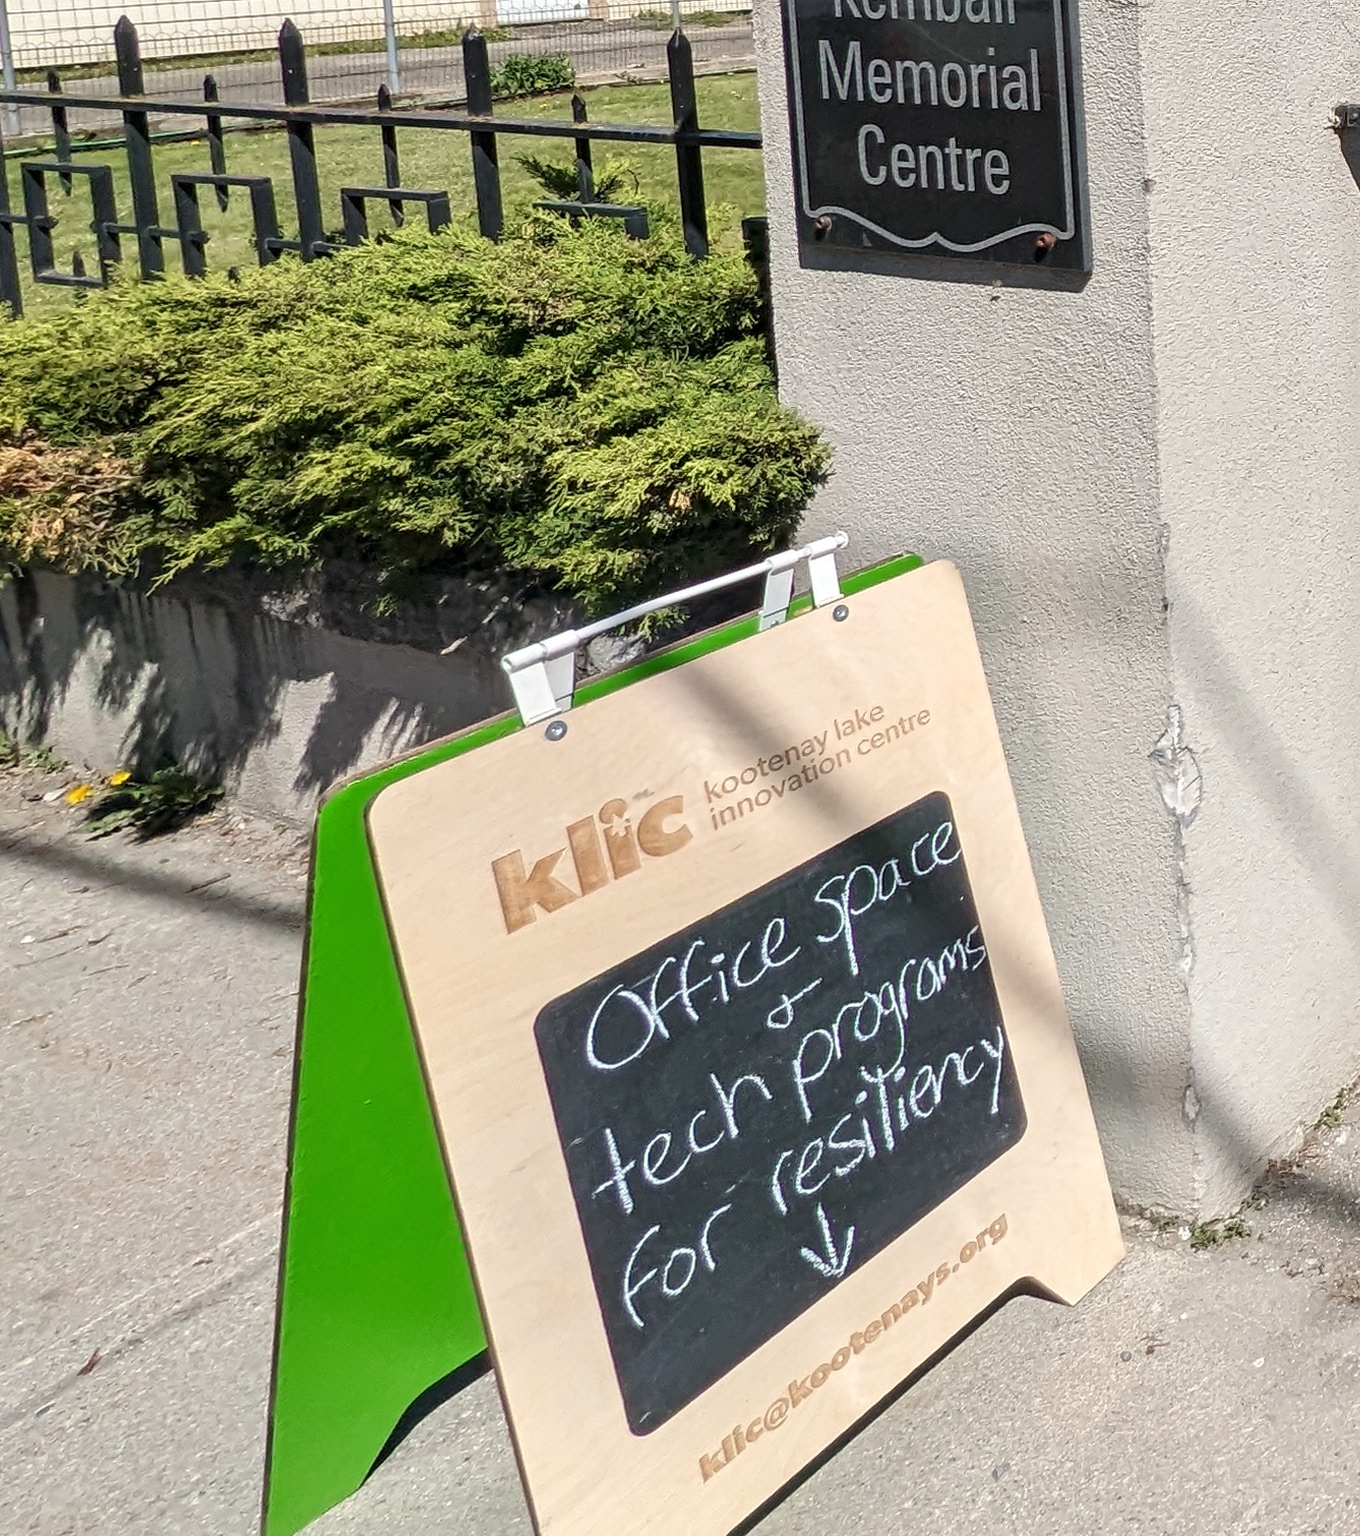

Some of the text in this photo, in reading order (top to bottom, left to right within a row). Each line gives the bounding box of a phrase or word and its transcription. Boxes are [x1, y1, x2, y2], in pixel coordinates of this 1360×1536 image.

[818, 39, 1041, 111] Memorial
[857, 123, 1011, 195] Centre
[703, 705, 885, 804] kootenay lake
[710, 709, 931, 830] innovation centre
[491, 795, 693, 935] klic
[586, 917, 800, 1070] Office
[592, 925, 986, 1214] tech programs
[622, 1026, 1004, 1328] for resiliency
[698, 1213, 1008, 1483] klic@kootenays.org
